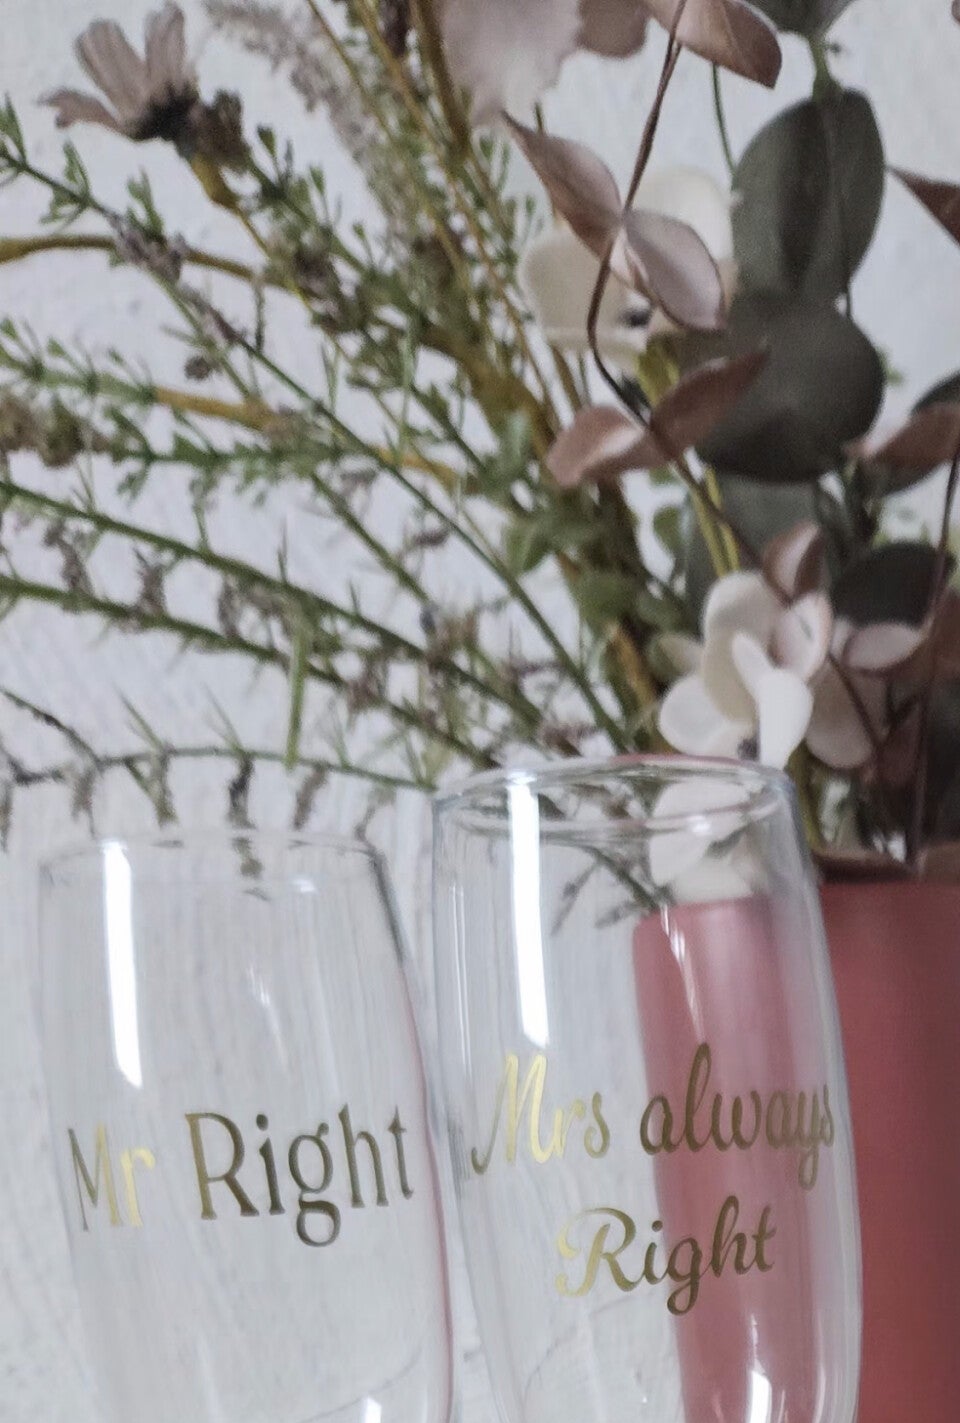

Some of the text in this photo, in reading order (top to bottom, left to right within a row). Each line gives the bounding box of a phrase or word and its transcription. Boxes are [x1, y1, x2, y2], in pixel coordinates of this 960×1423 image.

[67, 1102, 414, 1248] Mr Right
[471, 1042, 835, 1191] Mrs always
[555, 1194, 777, 1317] Right
